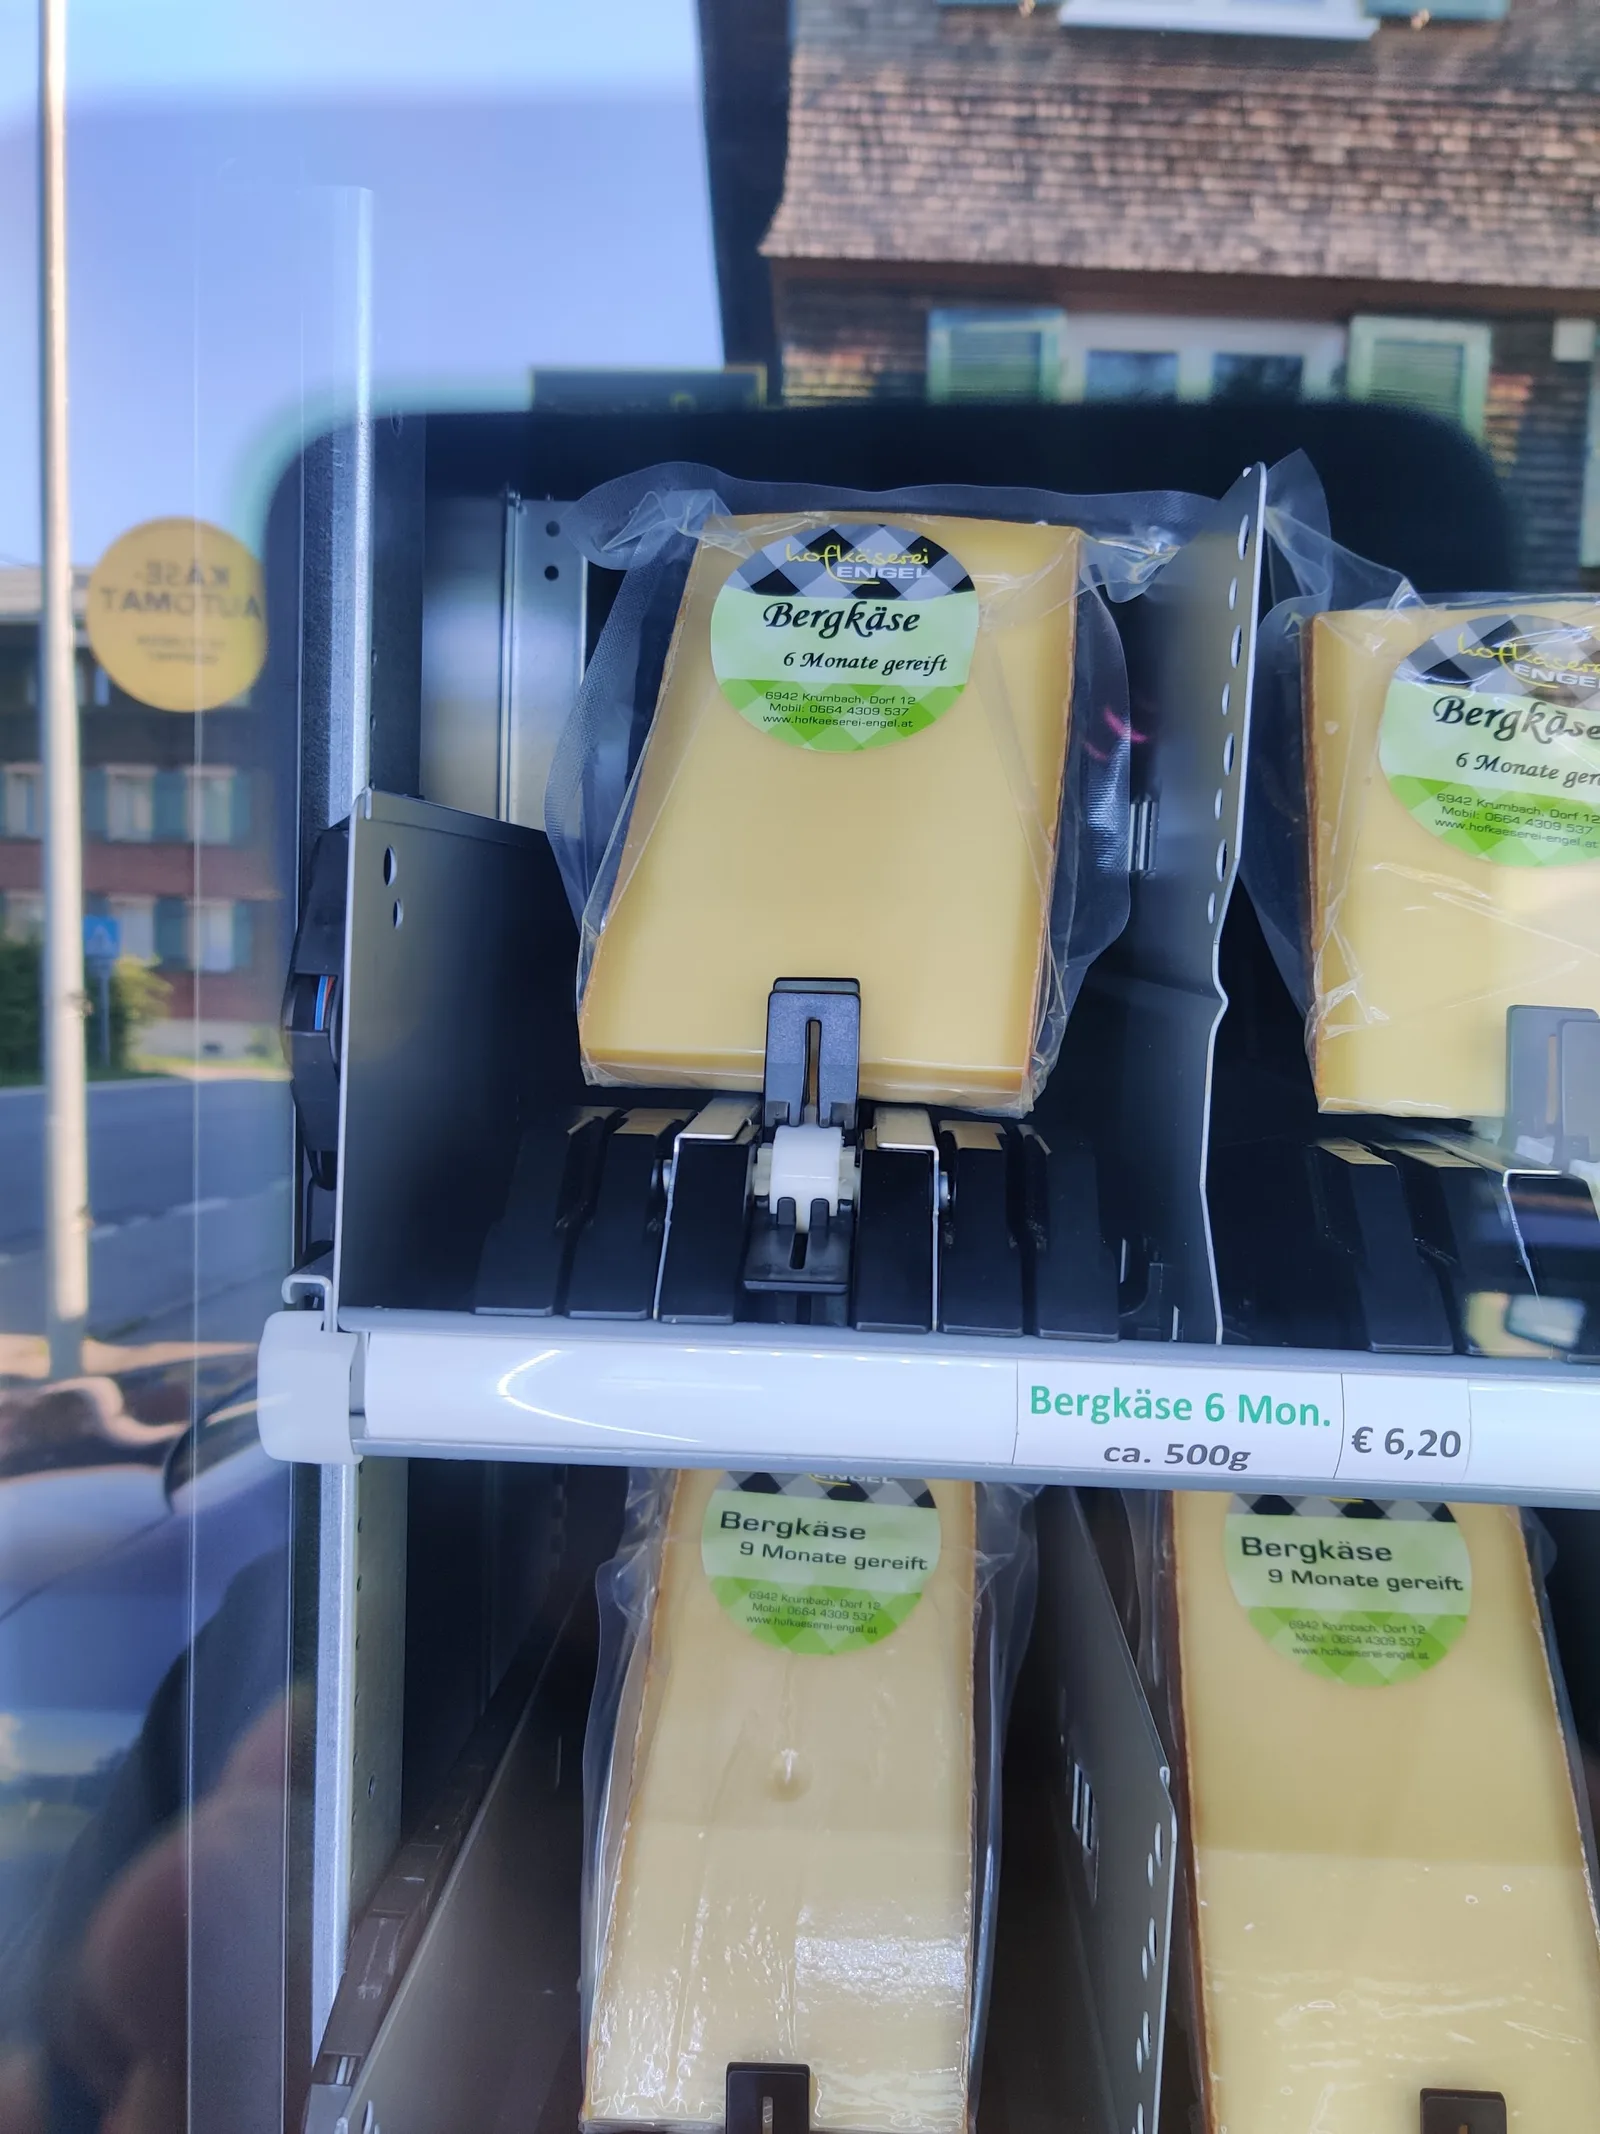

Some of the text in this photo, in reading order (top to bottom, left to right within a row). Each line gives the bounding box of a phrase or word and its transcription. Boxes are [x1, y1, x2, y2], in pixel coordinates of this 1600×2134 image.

[785, 543, 929, 573] hofkäserei
[836, 566, 931, 579] ENGEL
[763, 600, 921, 639] Bergkäse
[783, 651, 948, 677] 6 Monate gereift
[1512, 663, 1600, 689] ENGE
[765, 691, 916, 705] 6942 Krumbach, Dorf 12
[769, 702, 909, 717] Mobil: 0664 4309 537
[763, 714, 913, 728] www.hofkaeserei-engel.at
[1433, 695, 1600, 744] Bergkäse
[1456, 752, 1470, 768] 6
[1473, 754, 1559, 780] Monate
[1437, 792, 1472, 806] 6942
[1550, 808, 1578, 821] Dorf
[1583, 812, 1600, 824] 12
[1441, 805, 1593, 836] Mobil: 0664 4309 537
[1434, 818, 1599, 849] www.hofkaeserei-engel.at
[1030, 1385, 1332, 1427] Bergkäse 6 Mon.
[1103, 1443, 1251, 1471] ca. 500g
[1351, 1426, 1462, 1461] € 6,20
[720, 1510, 866, 1540] Bergkäse
[739, 1541, 928, 1571] 9 Monate gereift
[1241, 1536, 1393, 1564] Bergkäse
[1268, 1568, 1464, 1593] 9 Monate gereift
[749, 1590, 778, 1602] 6942
[840, 1599, 863, 1609] Dorf
[787, 1606, 816, 1617] 0664
[820, 1609, 849, 1619] 4309
[852, 1612, 874, 1622] 537
[1289, 1620, 1319, 1631] 6942
[1383, 1624, 1408, 1634] Dorf
[1411, 1624, 1427, 1635] 12
[1365, 1635, 1396, 1646] 4309
[1399, 1637, 1422, 1648] 537
